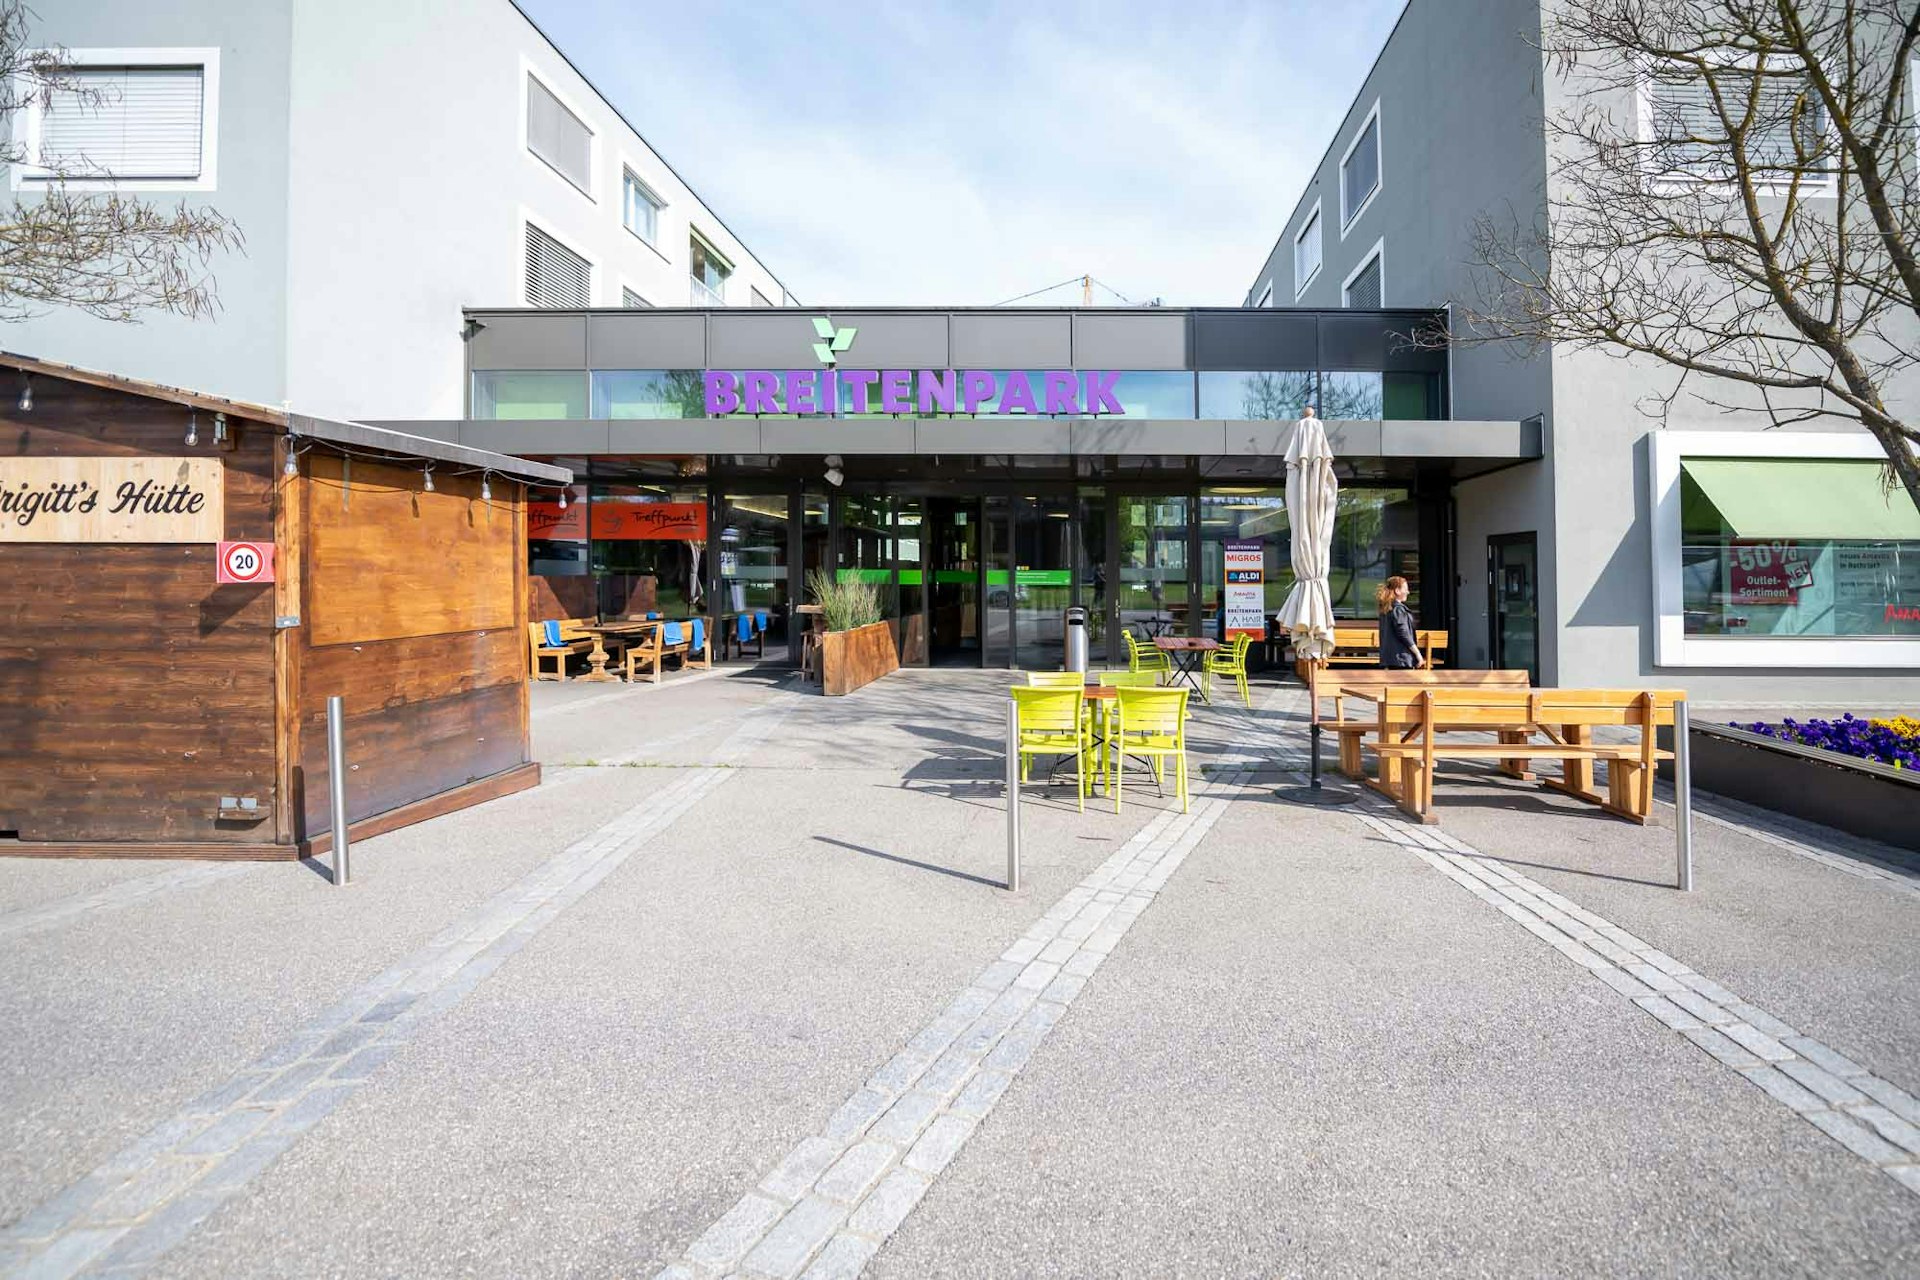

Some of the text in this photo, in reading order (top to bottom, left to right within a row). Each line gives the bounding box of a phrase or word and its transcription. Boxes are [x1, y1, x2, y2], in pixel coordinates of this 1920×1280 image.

[705, 369, 1126, 415] BREITENPARK
[0, 479, 205, 526] rigitt's Hütte
[528, 511, 577, 528] ffpunkt
[632, 509, 698, 527] Treffpunkt
[235, 554, 253, 570] 20
[1239, 572, 1260, 580] ALDI
[1746, 575, 1781, 585] Outlet-
[1740, 588, 1789, 597] Sortiment
[1242, 615, 1262, 623] HAIR
